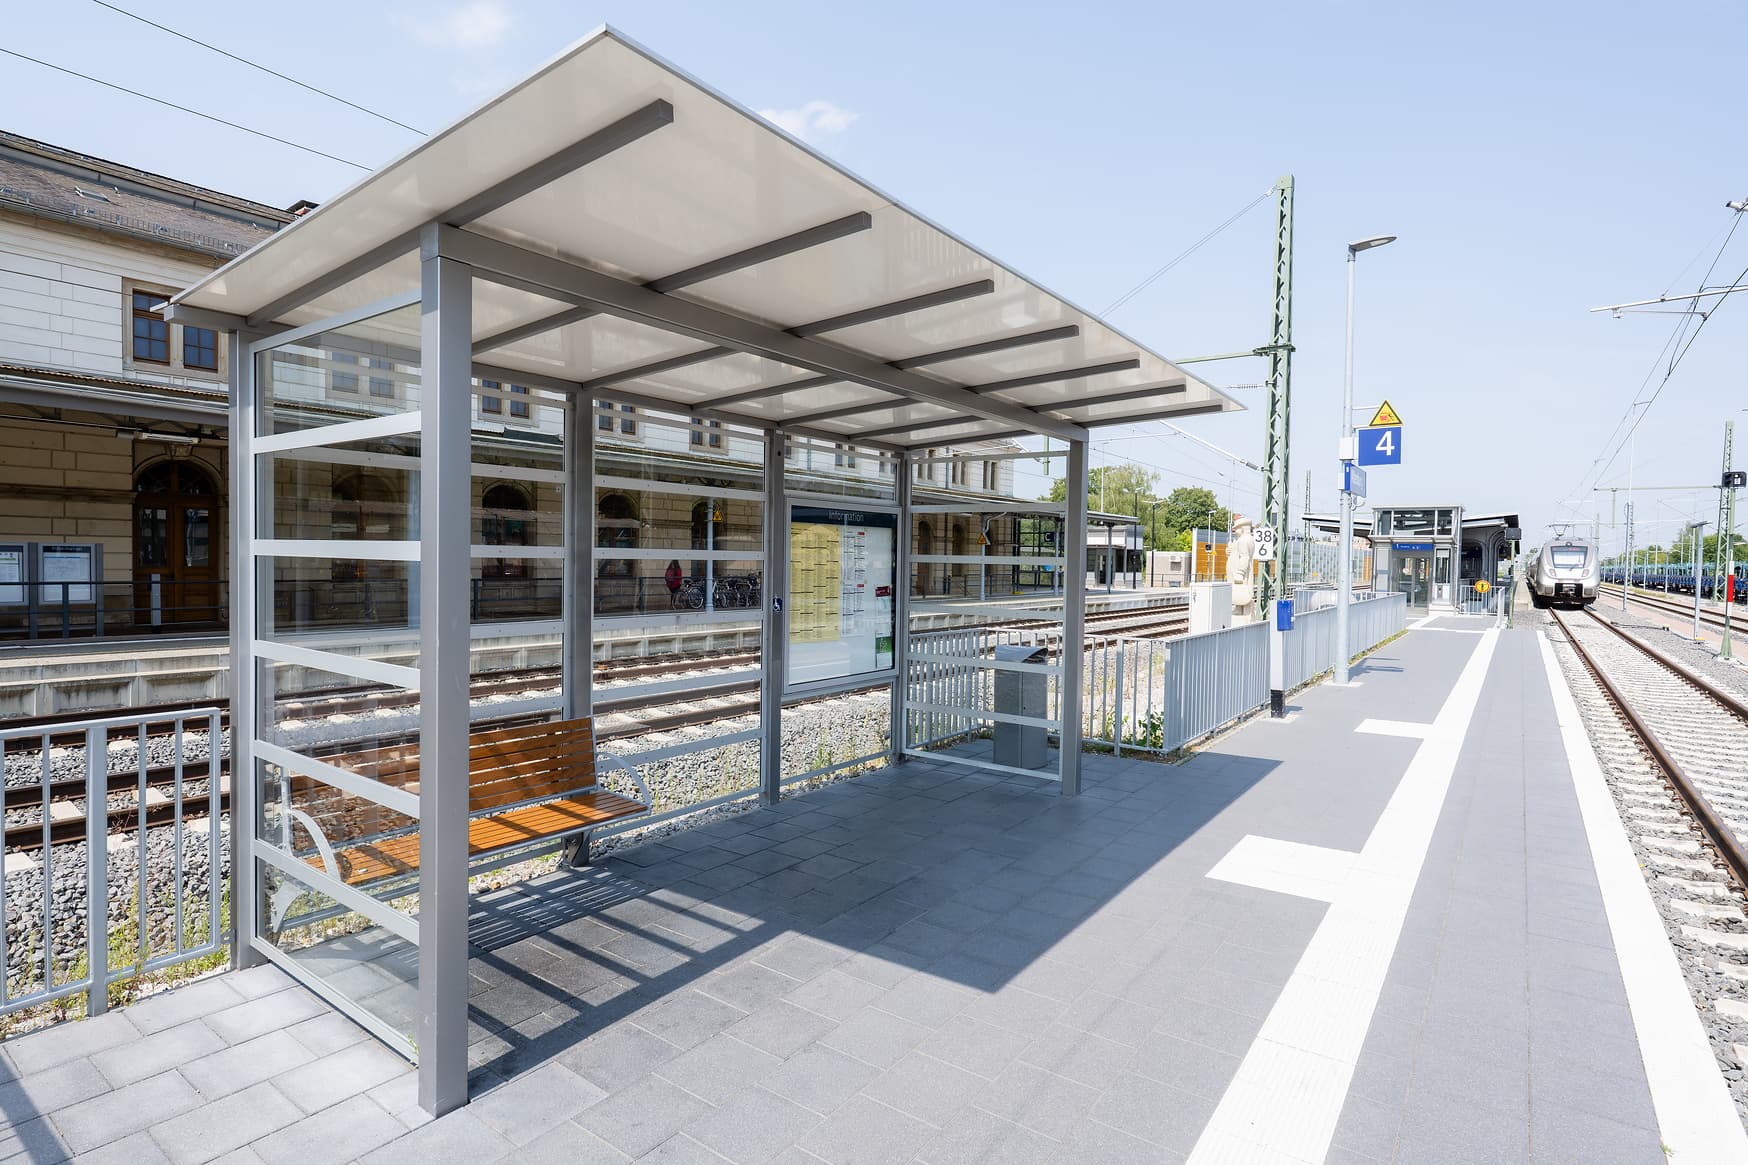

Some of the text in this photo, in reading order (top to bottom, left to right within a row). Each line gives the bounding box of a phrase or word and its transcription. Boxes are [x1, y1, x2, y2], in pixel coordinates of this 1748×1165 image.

[1375, 430, 1395, 456] 4
[1255, 530, 1272, 543] 38
[1258, 543, 1268, 556] 6
